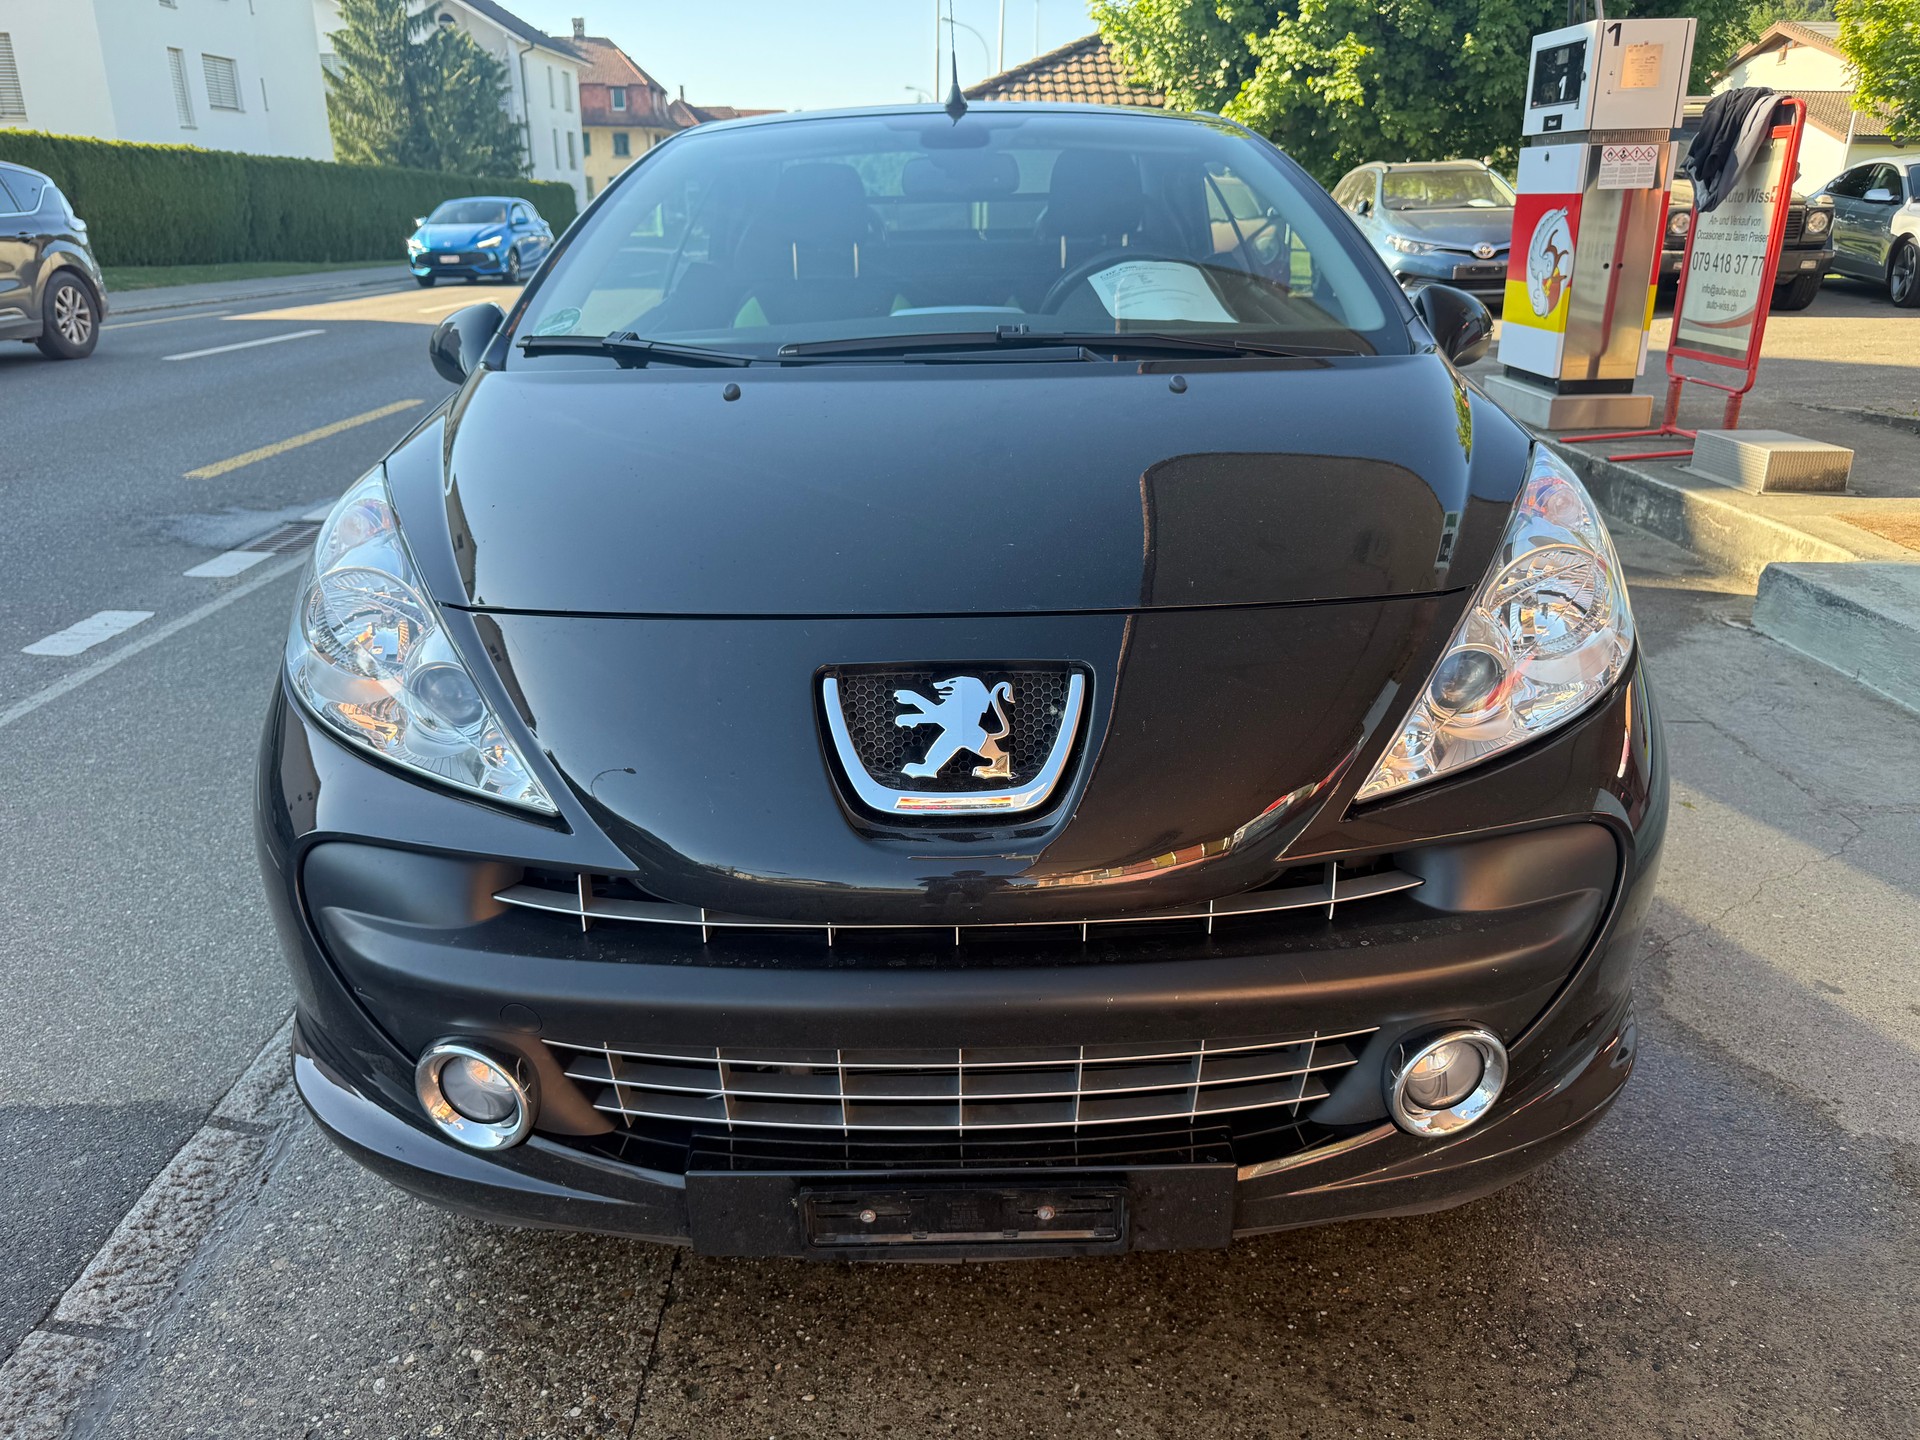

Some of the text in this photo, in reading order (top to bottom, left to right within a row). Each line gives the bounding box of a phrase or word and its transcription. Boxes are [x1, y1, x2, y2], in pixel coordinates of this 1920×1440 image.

[1607, 22, 1622, 46] 1
[1558, 75, 1567, 100] 1
[1746, 187, 1770, 203] Wiss
[1730, 216, 1751, 226] Verkauf
[1751, 218, 1761, 226] von
[1696, 229, 1725, 241] Occasionen
[1725, 232, 1732, 241] zu
[1692, 251, 1766, 277] 079 418 37 77
[1706, 300, 1737, 312] auto-wiss.ch
